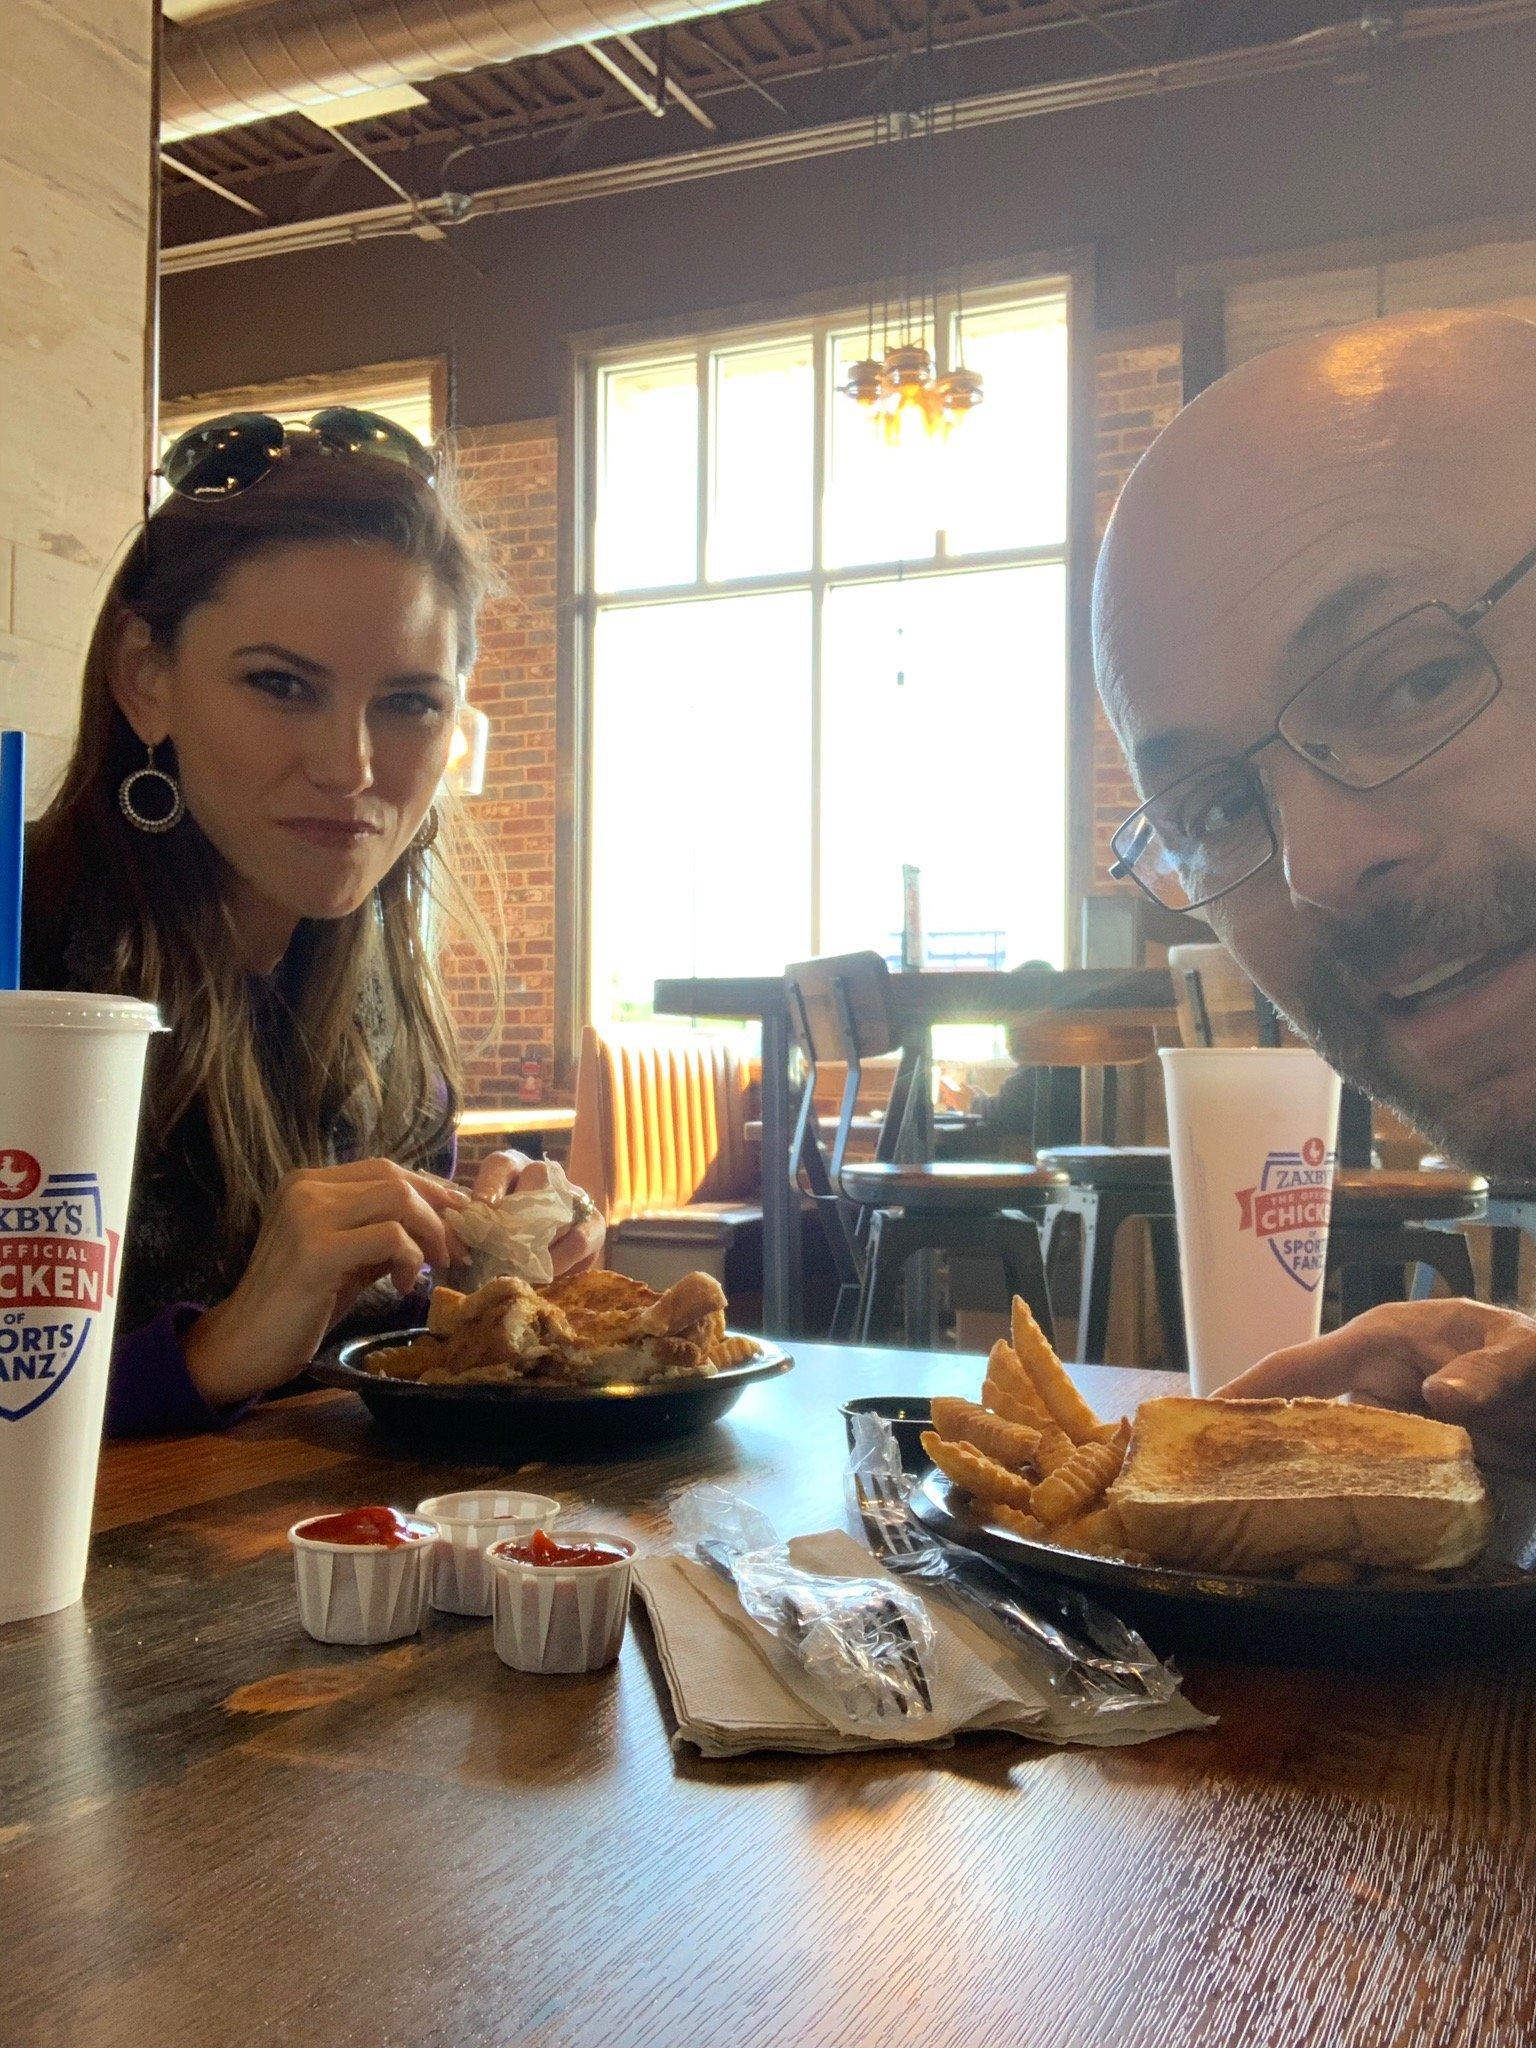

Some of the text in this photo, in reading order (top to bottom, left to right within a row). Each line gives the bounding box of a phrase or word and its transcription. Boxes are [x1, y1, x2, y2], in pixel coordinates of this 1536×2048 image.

[1262, 1203, 1331, 1229] CHICK
[2, 1244, 87, 1262] FFICIAL
[0, 1265, 98, 1303] CKEN
[4, 1313, 25, 1324] OF
[0, 1324, 73, 1354] ORTS
[0, 1353, 56, 1382] ANZ
